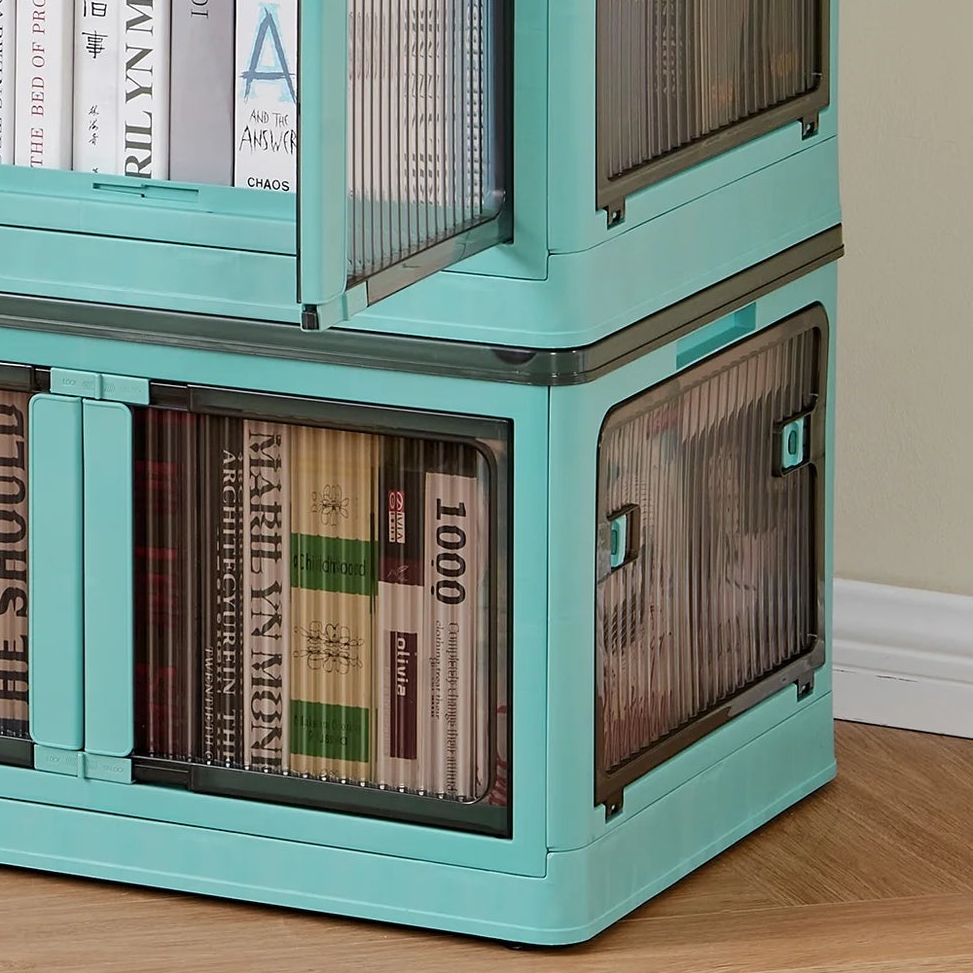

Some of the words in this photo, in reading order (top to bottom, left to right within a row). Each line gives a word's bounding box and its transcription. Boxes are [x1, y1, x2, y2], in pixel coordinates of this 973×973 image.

[33, 41, 46, 68] OF
[31, 76, 45, 116] BED
[250, 109, 270, 124] AND
[272, 111, 289, 127] THE
[29, 127, 45, 168] THE
[239, 124, 297, 156] ANSWER
[247, 177, 291, 192] CHAOS
[433, 497, 467, 605] 1000
[396, 637, 410, 697] olivia
